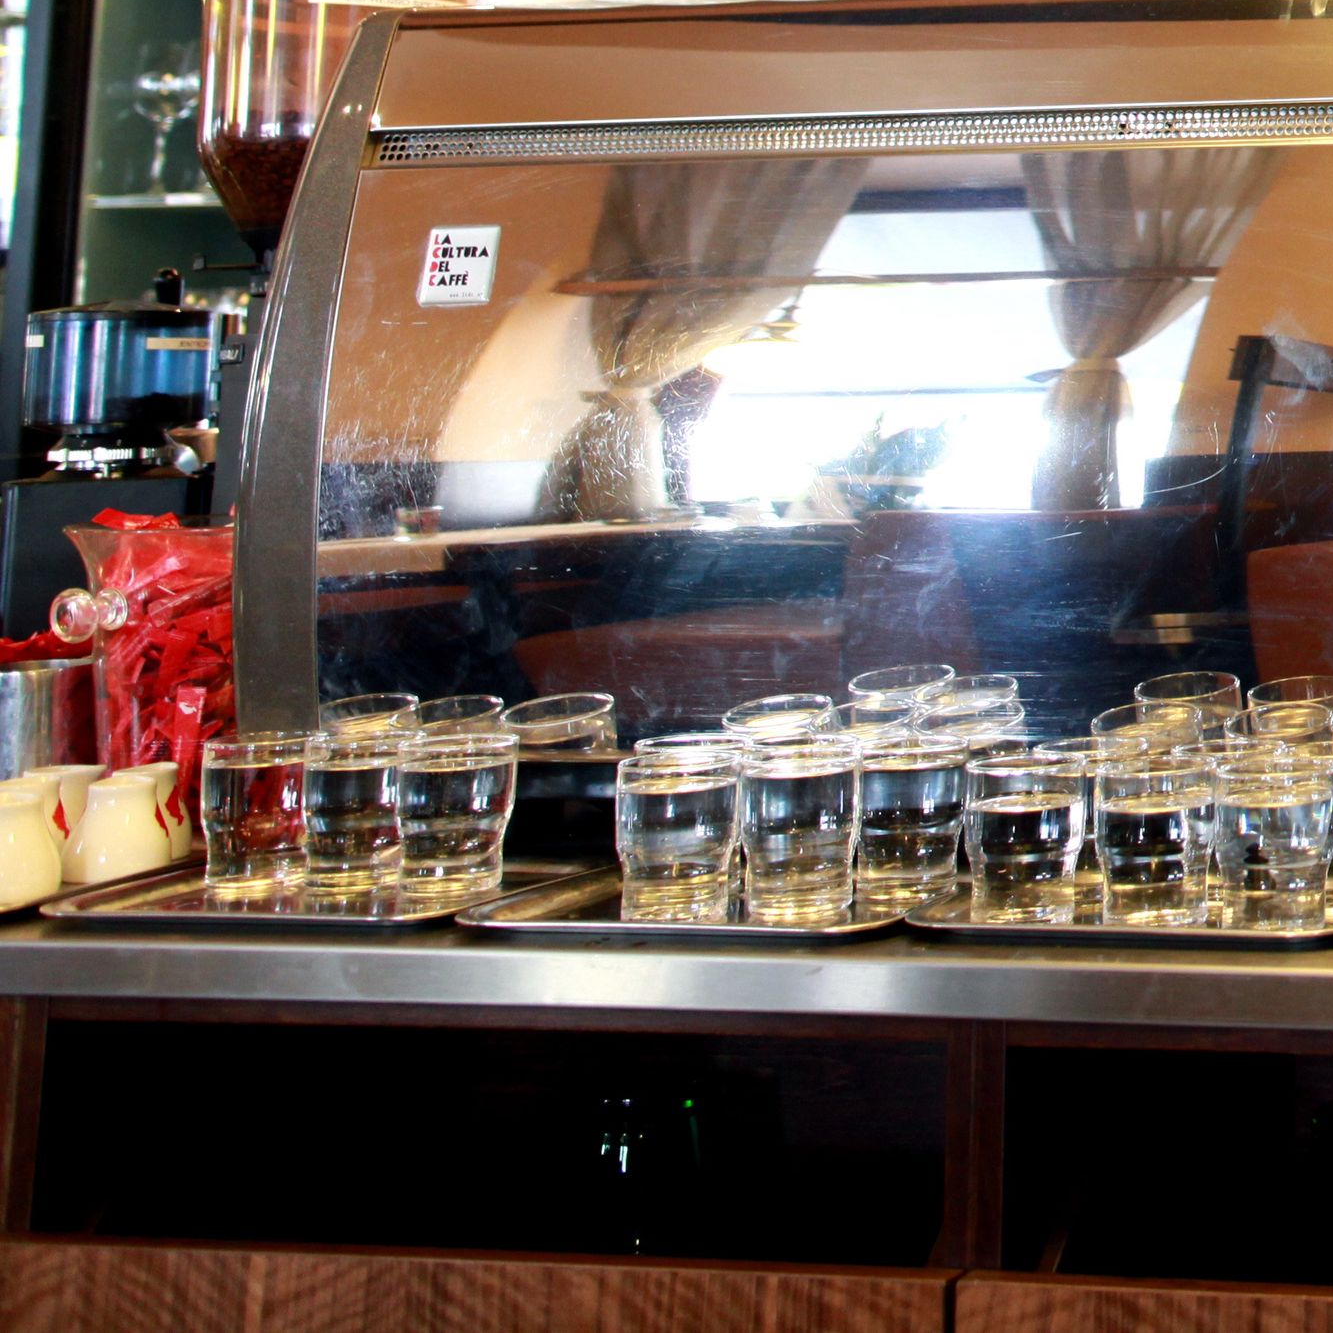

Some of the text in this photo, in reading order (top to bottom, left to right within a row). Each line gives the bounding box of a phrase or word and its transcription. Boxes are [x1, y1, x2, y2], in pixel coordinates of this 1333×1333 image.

[434, 233, 452, 245] LA
[432, 246, 489, 259] CULTURA
[429, 261, 450, 273] DEL
